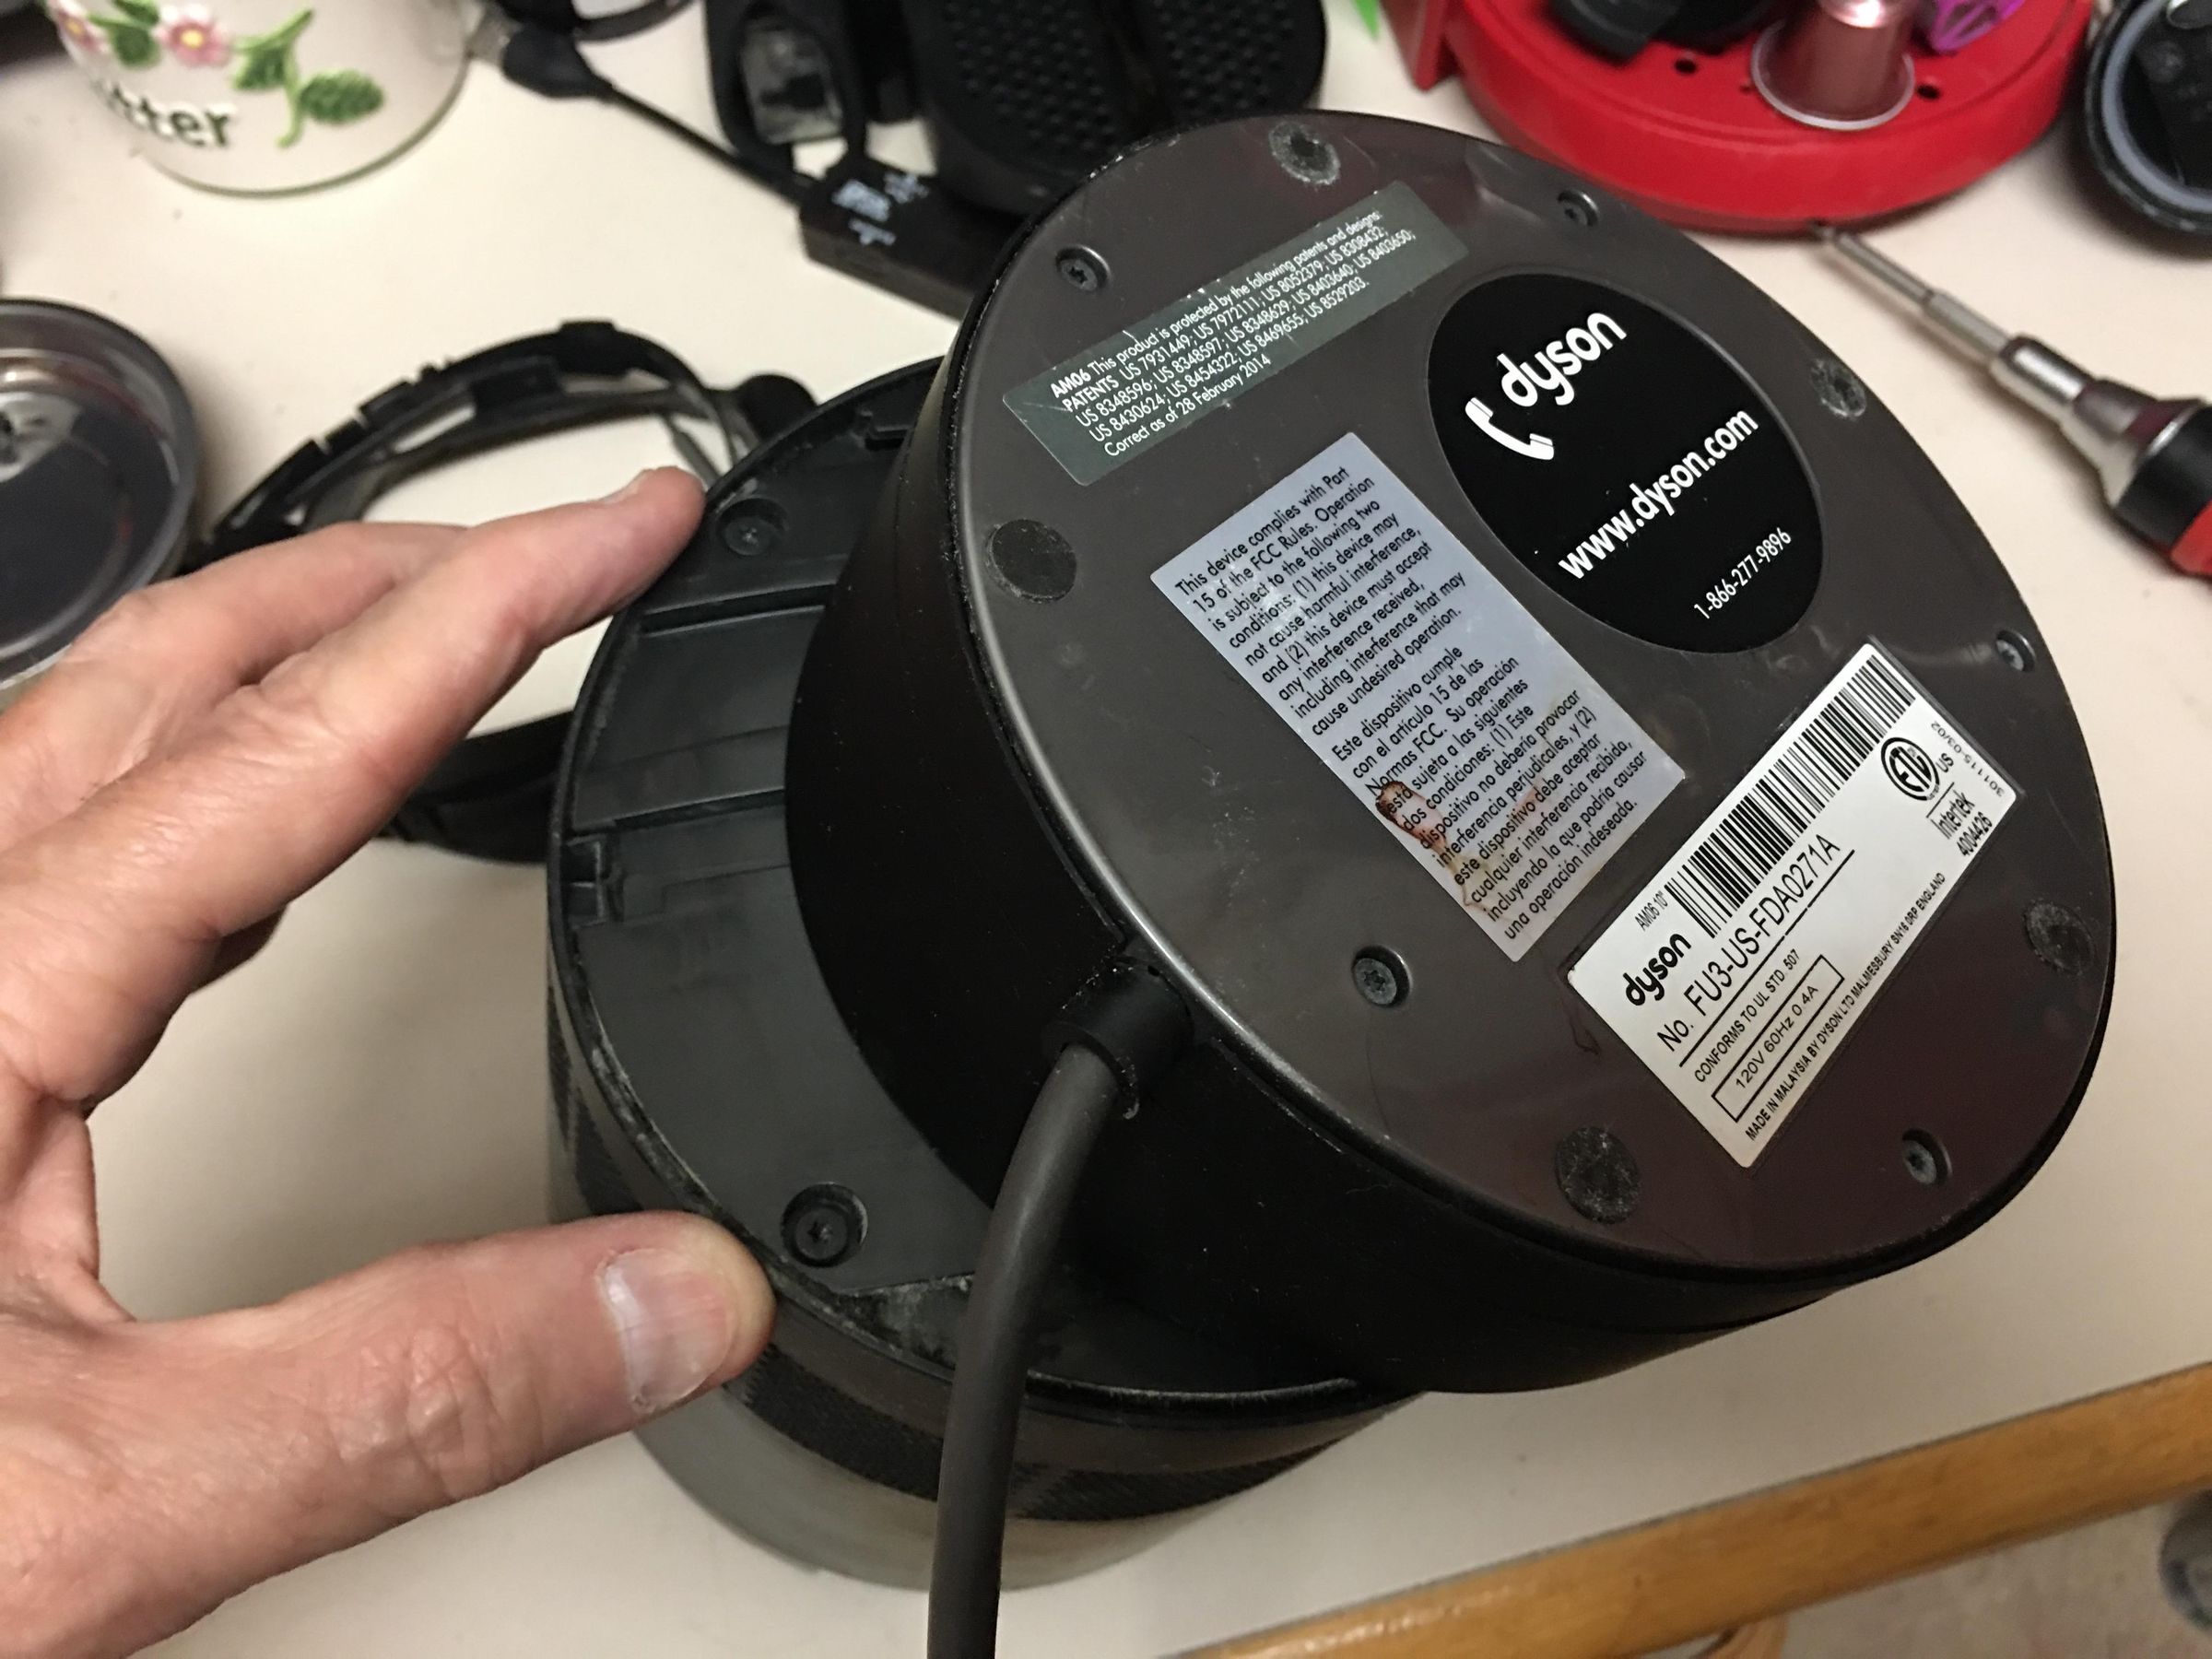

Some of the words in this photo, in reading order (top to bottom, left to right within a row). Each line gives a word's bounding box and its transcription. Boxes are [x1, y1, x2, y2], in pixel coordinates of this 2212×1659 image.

[1051, 368, 1091, 402] AM06
[1087, 357, 1117, 380] This
[1115, 332, 1159, 366] product
[1155, 327, 1171, 339] is
[1169, 298, 1218, 336] protected
[1214, 294, 1233, 306] by
[1230, 285, 1251, 299] the
[1246, 260, 1296, 289] following
[1293, 241, 1328, 267] patents
[1326, 227, 1347, 246] and
[1062, 375, 1119, 413] PATENTS
[1119, 362, 1142, 381] US
[1137, 335, 1197, 371] 7931449;
[1193, 323, 1214, 339] US
[1210, 297, 1265, 330] 7972111;
[1261, 286, 1281, 301] US
[1277, 260, 1329, 292] 8052379;
[1324, 250, 1343, 265] US
[1339, 226, 1388, 256] 8308432;
[1075, 408, 1100, 431] US
[1096, 378, 1158, 416] 8348596;
[1152, 366, 1174, 383] US
[1171, 336, 1230, 373] 8348597;
[1224, 325, 1245, 343] US
[1241, 300, 1296, 333] 8348629;
[1291, 288, 1311, 304] US
[1307, 264, 1359, 296] 8403640;
[1353, 253, 1372, 268] US
[1368, 229, 1417, 261] 8403650;
[1088, 423, 1112, 444] US
[1109, 393, 1171, 431] 8430624;
[1166, 380, 1188, 397] US
[1184, 351, 1242, 387] 8454322;
[1237, 340, 1258, 357] US
[1254, 309, 1309, 347] 8469655;
[1303, 302, 1324, 318] US
[1320, 276, 1370, 310] 8529203.
[1496, 312, 1628, 407] dyson
[1104, 425, 1150, 456] Correct
[1149, 418, 1166, 432] as
[1165, 406, 1179, 423] of
[1175, 397, 1196, 416] 28
[1192, 372, 1243, 406] February
[1239, 353, 1271, 378] 2014
[1174, 573, 1208, 596] This
[1206, 544, 1248, 577] device
[1248, 505, 1301, 547] complies
[1298, 484, 1326, 507] with
[1322, 466, 1349, 489] Part
[1193, 592, 1216, 613] 15
[1216, 578, 1232, 599] of
[1229, 568, 1253, 587] the
[1250, 543, 1282, 571] FCC
[1277, 523, 1318, 550] Rules.
[1314, 477, 1375, 523] Operation
[1225, 582, 1270, 622] subject
[1266, 573, 1285, 587] to
[1281, 558, 1306, 576] the
[1301, 516, 1361, 560] following
[1355, 500, 1381, 520] two
[1558, 409, 1759, 579] www.dyson.com
[1229, 594, 1296, 649] conditions:
[1292, 576, 1317, 599] (1)
[1311, 561, 1337, 582] this
[1335, 534, 1373, 565] device
[1372, 512, 1399, 537] may
[1244, 642, 1269, 666] not
[1268, 616, 1305, 647] cause
[1300, 574, 1352, 619] harmful
[1346, 527, 1421, 582] interference,
[1262, 654, 1289, 684] and
[1284, 641, 1310, 665] (2)
[1304, 625, 1331, 647] this
[1329, 595, 1369, 629] device
[1367, 570, 1396, 598] must
[1395, 540, 1432, 575] accept
[1278, 677, 1305, 701] any
[1298, 620, 1373, 681] interference
[1371, 577, 1425, 624] received,
[1693, 526, 1792, 619] 1-866-277-9896
[1289, 668, 1354, 719] including
[1346, 613, 1418, 672] interference
[1414, 591, 1441, 616] that
[1439, 571, 1465, 596] may
[1312, 702, 1348, 735] cause
[1347, 649, 1406, 705] undesired
[1405, 608, 1462, 655] operation.
[1331, 735, 1363, 762] Este
[1360, 683, 1422, 738] dispositivo
[1421, 647, 1463, 686] cumple
[1352, 755, 1378, 779] con
[1389, 704, 1433, 746] artículo
[1430, 685, 1450, 705] 15
[1448, 675, 1466, 691] de
[1461, 658, 1484, 677] las
[1364, 750, 1418, 796] Normas
[1412, 723, 1448, 754] FCC.
[1445, 705, 1466, 723] Su
[1465, 657, 1519, 708] operación
[1411, 754, 1449, 790] sujeta
[1452, 728, 1477, 747] las
[1474, 679, 1528, 732] siguientes
[1414, 791, 1479, 850] dispositivo
[1493, 734, 1537, 776] debería
[1535, 689, 1581, 740] provocar
[1420, 743, 1495, 810] condiciones:
[1489, 724, 1513, 747] (1)
[1505, 706, 1534, 730] Este
[1936, 752, 1955, 773] US
[1431, 796, 1508, 868] interferencia
[1505, 735, 1574, 802] perjudicales,
[1574, 706, 1597, 729] (2)
[1453, 858, 1481, 890] este
[1477, 801, 1535, 860] dispositivo
[1533, 773, 1564, 803] debe
[1561, 733, 1601, 775] aceptar
[1471, 846, 1524, 904] cualquier
[1517, 781, 1589, 851] interferencia
[1585, 741, 1633, 784] recibida,
[1482, 858, 1547, 922] incluyendo
[1559, 822, 1583, 846] que
[1579, 786, 1616, 828] podría
[1613, 750, 1647, 788] causar
[1931, 790, 1975, 840] Intertek
[1957, 811, 1993, 856] 4004426
[1504, 912, 1531, 939] una
[1528, 855, 1583, 914] operación
[1576, 800, 1638, 857] indeseada.
[1635, 902, 1660, 931] AM06
[1622, 933, 1692, 1006] dyson
[1656, 1019, 1694, 1052] No.
[1683, 834, 1841, 1017] FU3-US-FDA0271A
[1745, 1109, 1771, 1141] MADE
[1765, 1098, 1779, 1113] IN
[1773, 1054, 1812, 1102] MALAYSIA
[1806, 1040, 1820, 1058] BY
[1816, 1011, 1843, 1044] DYSON
[1851, 940, 1894, 998] MALMESBURY
[1890, 922, 1909, 945] SN16
[1915, 873, 1946, 911] ENGLAND
[1694, 1020, 1746, 1082] CONFORMS
[1740, 1005, 1758, 1022] TO
[1753, 992, 1771, 1007] UL
[1783, 948, 1799, 971] 507
[1736, 1050, 1765, 1088] 120V
[1764, 1017, 1794, 1053] 60Hz
